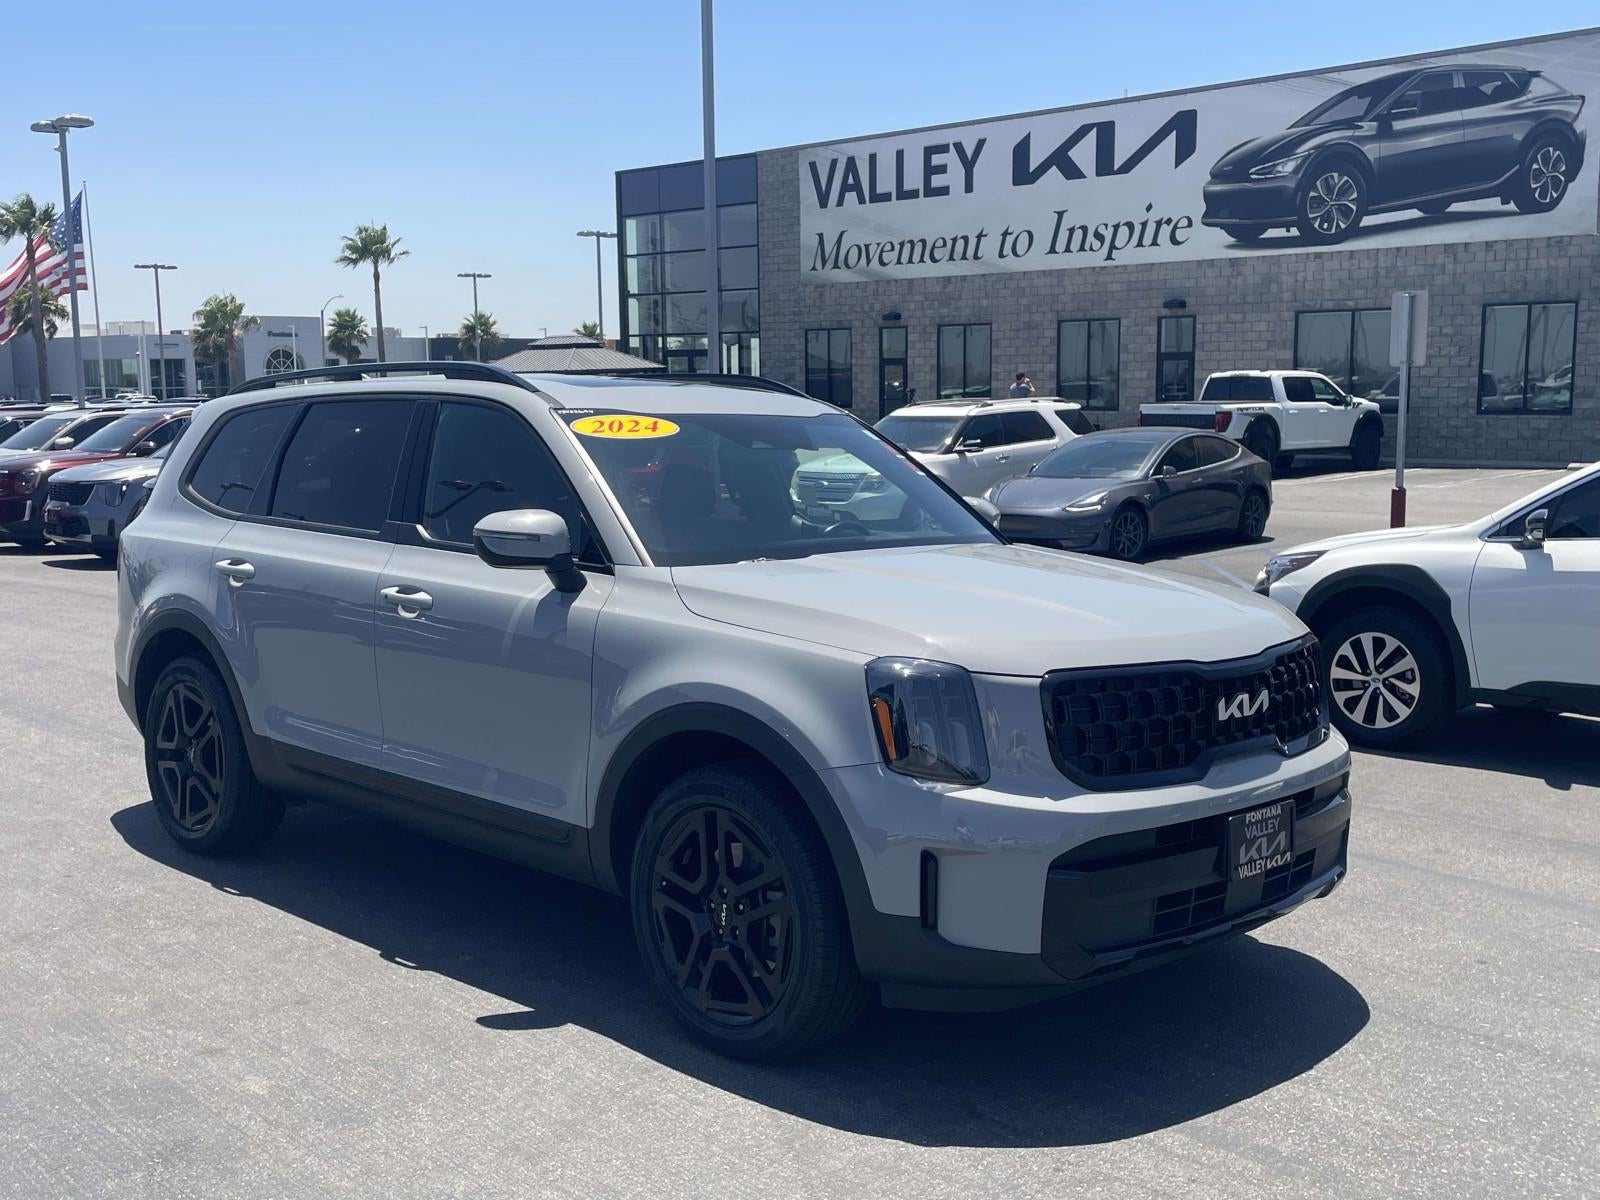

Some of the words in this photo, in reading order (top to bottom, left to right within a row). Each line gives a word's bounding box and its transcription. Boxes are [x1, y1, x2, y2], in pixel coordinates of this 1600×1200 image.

[808, 137, 987, 209] VALLEY
[1012, 109, 1198, 187] KIA
[809, 227, 989, 272] Movement
[998, 223, 1034, 259] to
[1045, 202, 1193, 261] Inspire
[591, 419, 659, 433] 2024
[1218, 689, 1270, 721] KIA
[1246, 804, 1281, 824] FONTANA
[1245, 817, 1280, 840] VALLEY
[1240, 831, 1286, 865] KIA
[1239, 858, 1266, 879] VALLEY
